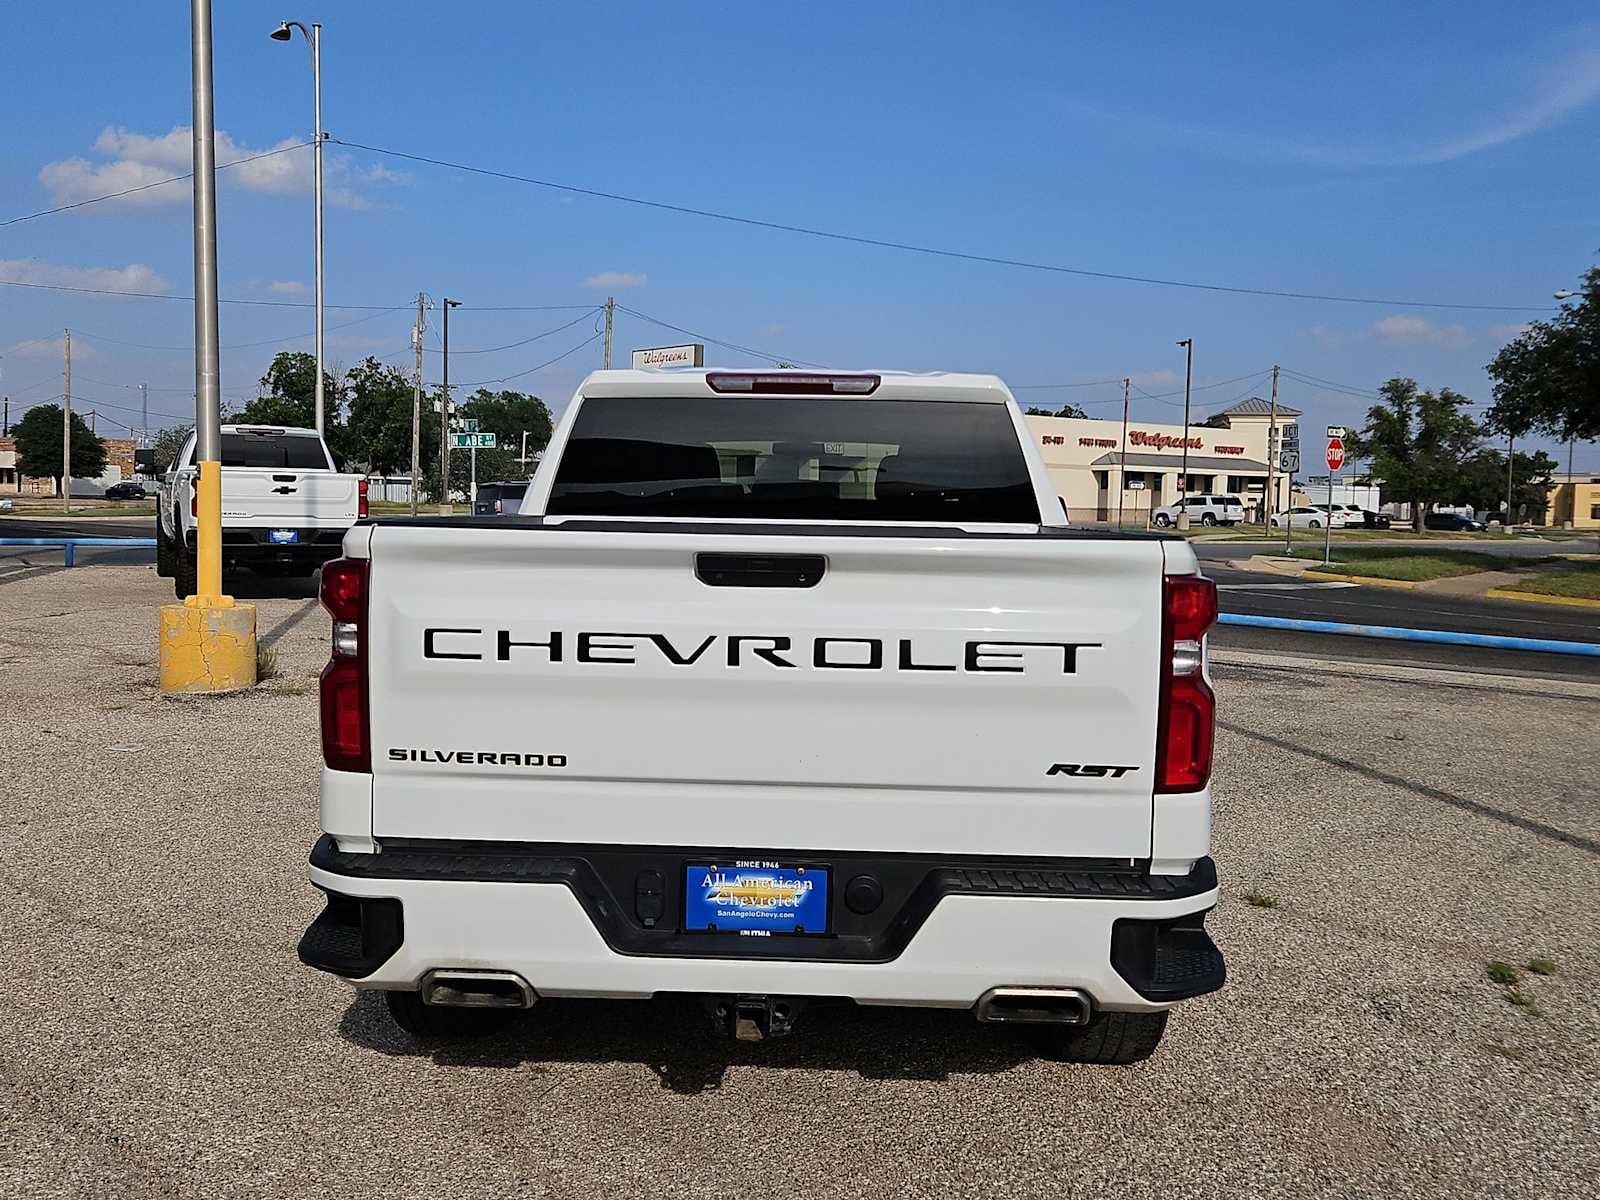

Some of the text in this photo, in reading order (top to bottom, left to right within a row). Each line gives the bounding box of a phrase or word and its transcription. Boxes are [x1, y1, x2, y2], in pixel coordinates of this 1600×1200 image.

[643, 351, 688, 366] Walgreens
[465, 435, 484, 446] ABE
[1128, 430, 1204, 451] Walgreens
[1281, 455, 1298, 468] 67
[1327, 447, 1344, 461] STOP
[423, 627, 1103, 674] CHEVROLET
[388, 748, 568, 768] SILVERADO
[1045, 763, 1141, 778] RST
[735, 860, 781, 869] SINCE 1946
[701, 872, 814, 892] All American
[716, 890, 800, 908] Chevrolet
[716, 909, 795, 919] SanAngeloChevy.com
